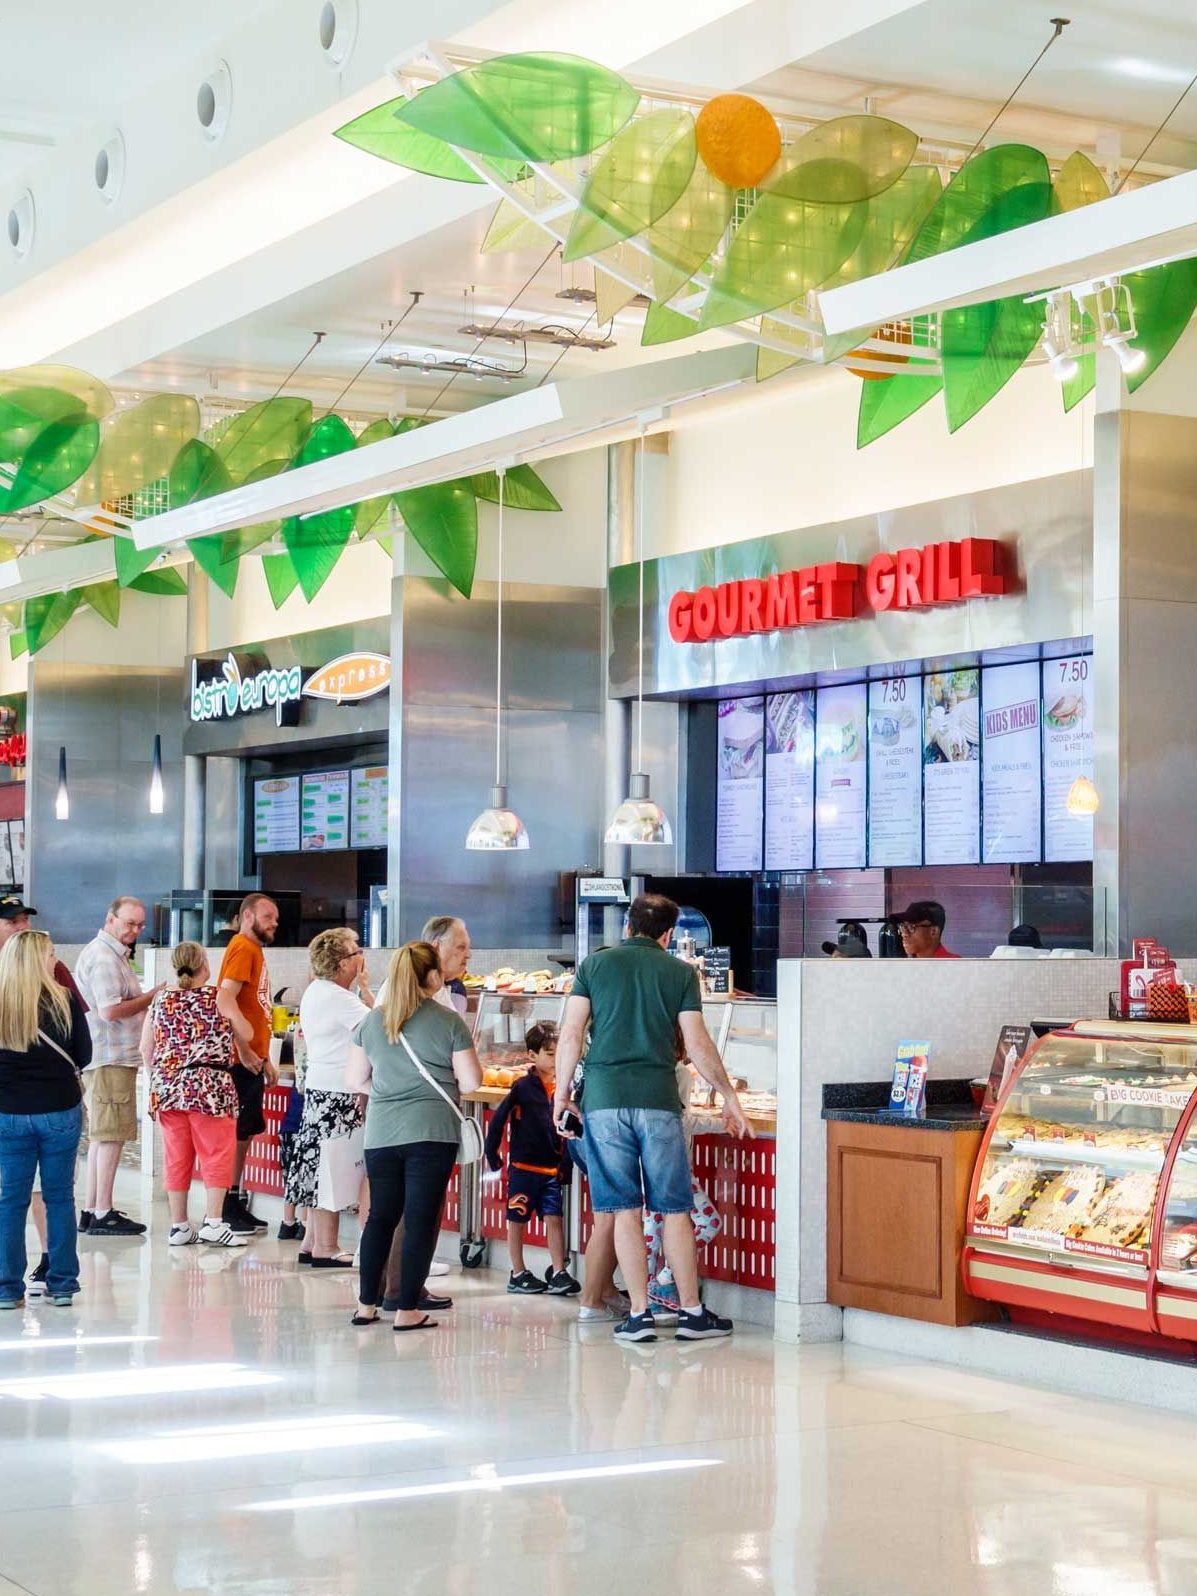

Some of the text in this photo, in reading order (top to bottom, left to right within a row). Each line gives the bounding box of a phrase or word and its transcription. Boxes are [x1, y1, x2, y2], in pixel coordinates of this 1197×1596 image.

[667, 537, 1004, 644] GOURMET GRILL
[318, 662, 386, 705] express
[1059, 660, 1088, 683] 7.50
[240, 665, 302, 727] europa
[882, 678, 906, 704] 7.50
[985, 703, 1037, 737] KIDS MENU
[1129, 1090, 1163, 1104] COOKIE
[1164, 1094, 1188, 1106] AKE
